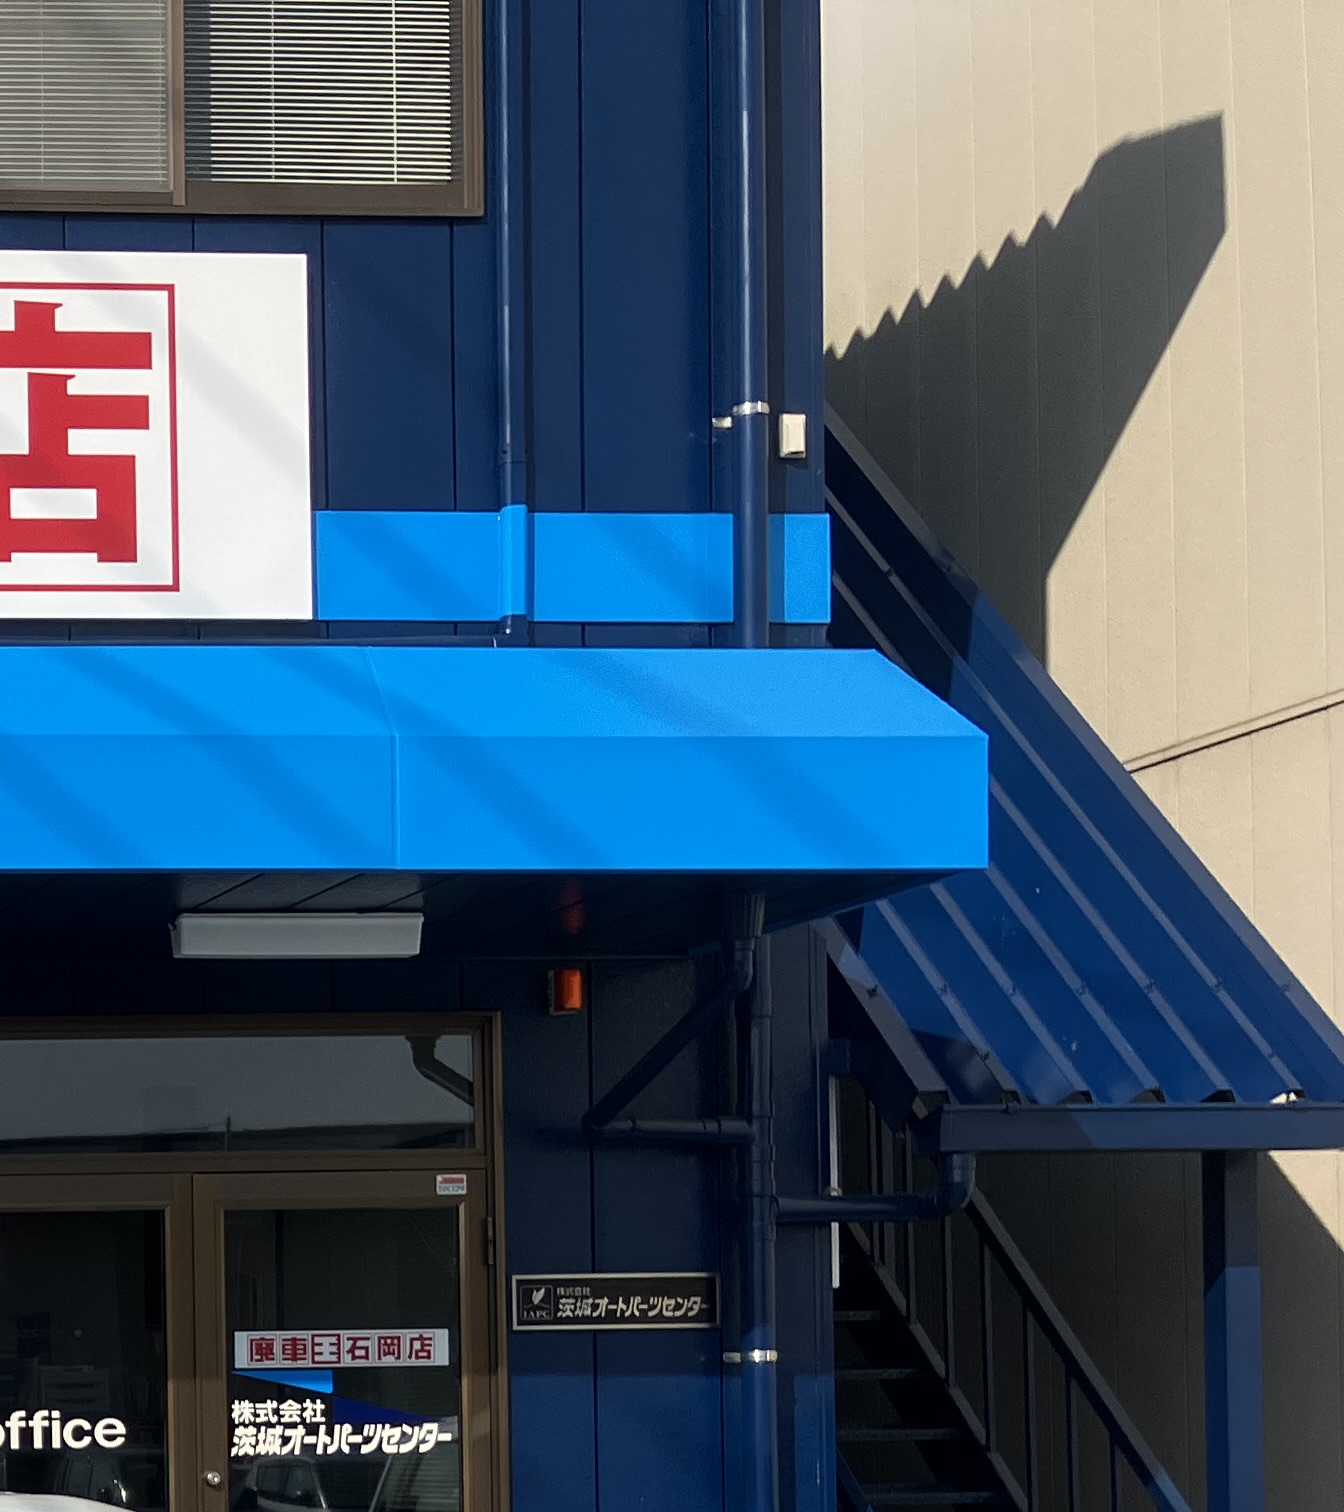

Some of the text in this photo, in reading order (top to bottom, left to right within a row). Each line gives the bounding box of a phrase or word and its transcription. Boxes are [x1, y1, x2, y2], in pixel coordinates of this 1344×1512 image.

[556, 1295, 710, 1318] 茨城オートパーツセンター
[231, 1398, 326, 1424] 株式会社
[230, 1422, 453, 1457] 茨城オートパーツセンター
